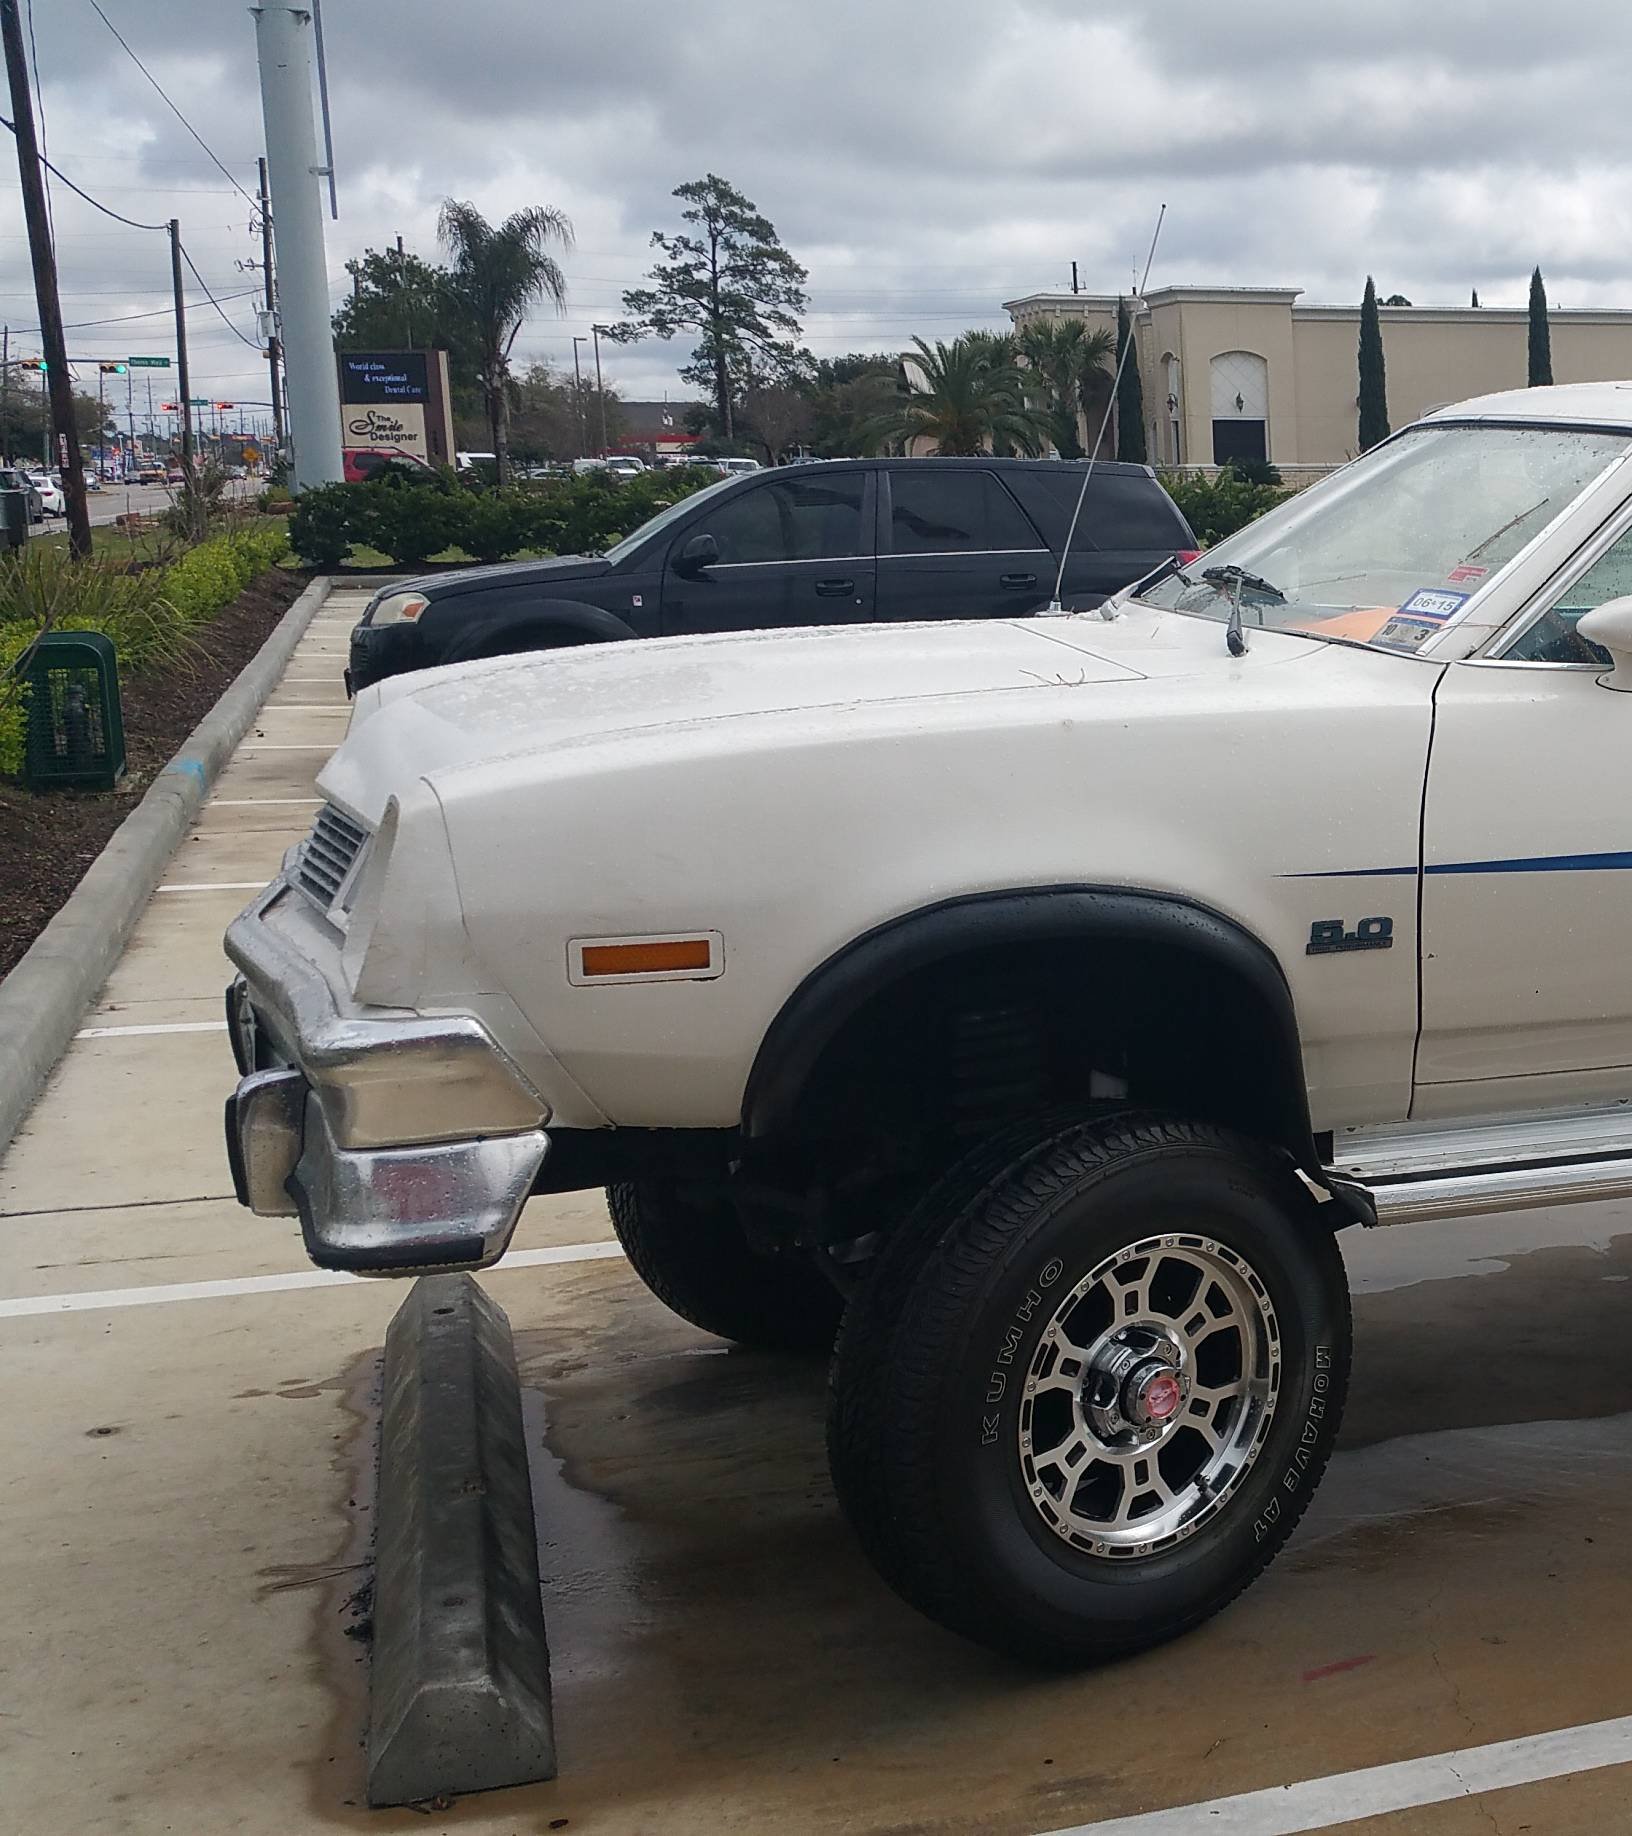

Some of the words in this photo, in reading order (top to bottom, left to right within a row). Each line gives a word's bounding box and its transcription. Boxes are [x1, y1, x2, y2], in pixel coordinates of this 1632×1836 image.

[348, 362, 369, 371] World
[364, 373, 370, 382] &
[372, 373, 407, 384] exceptional
[384, 385, 406, 394] Dental
[349, 410, 404, 436] Smile
[370, 432, 418, 444] Designer
[1310, 916, 1394, 944] 5.0
[979, 1256, 1065, 1447] KUMHO
[1283, 1344, 1331, 1494] MOHAVE
[1253, 1496, 1282, 1544] AT
